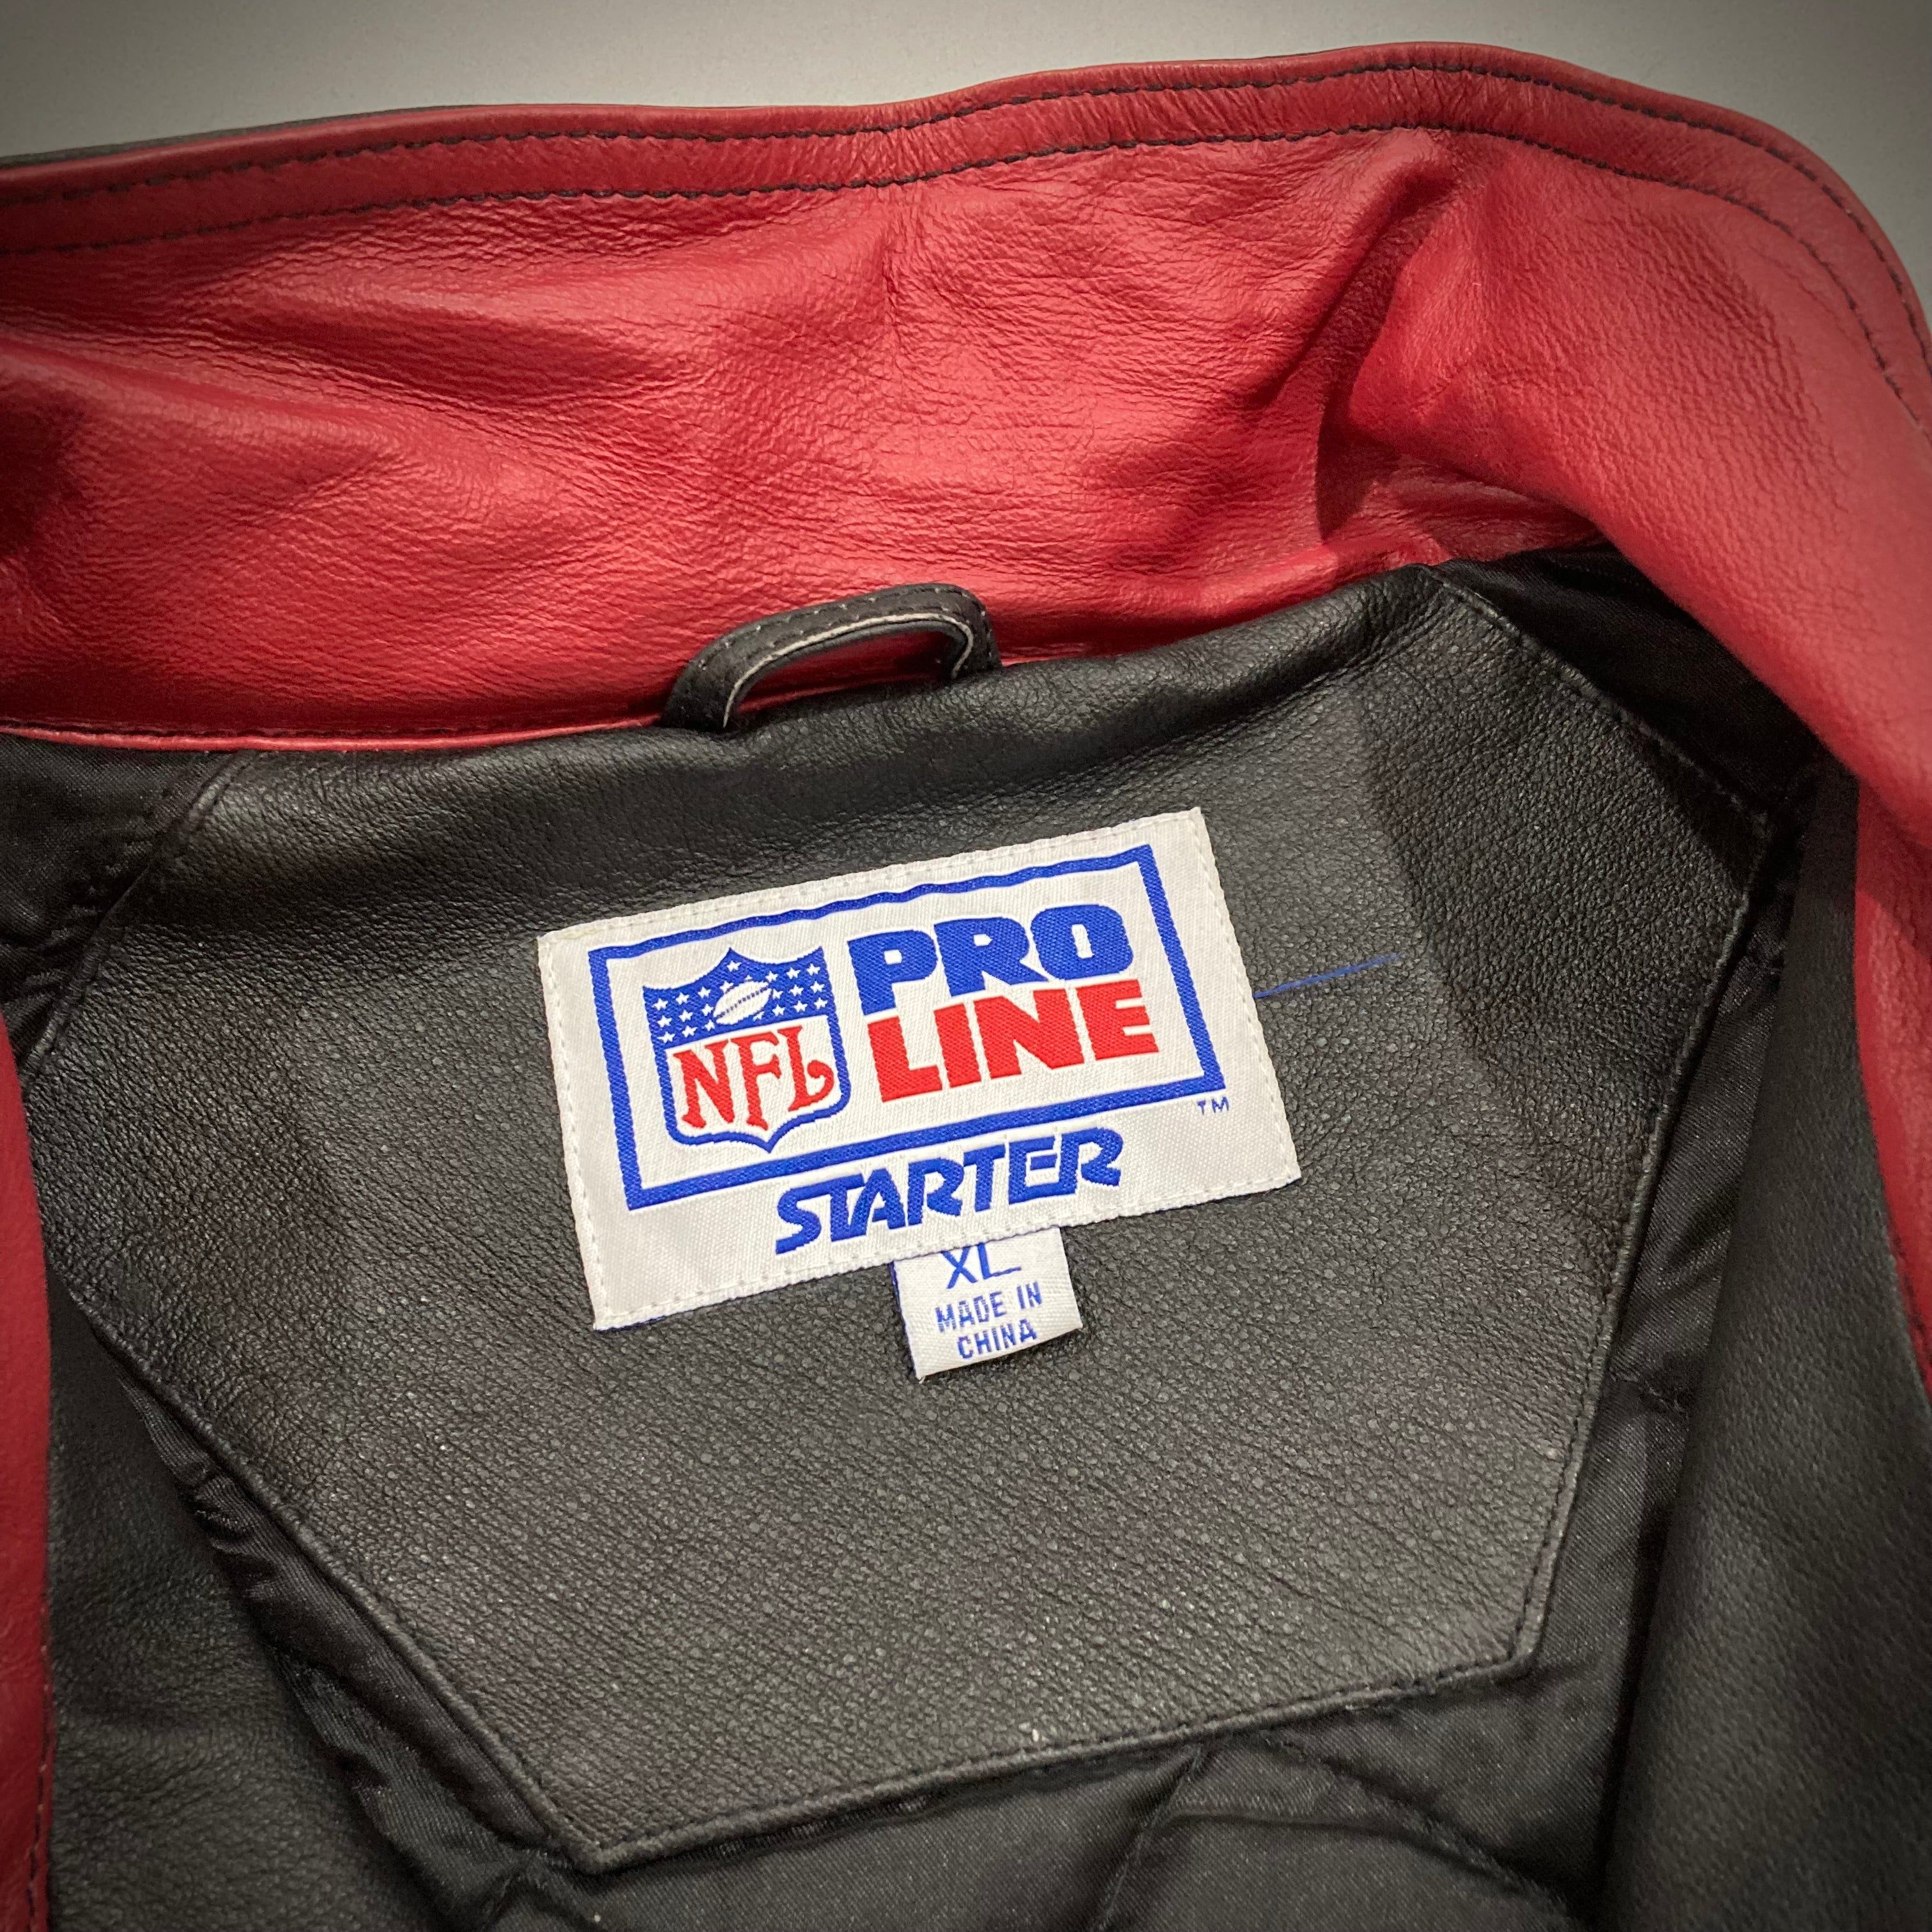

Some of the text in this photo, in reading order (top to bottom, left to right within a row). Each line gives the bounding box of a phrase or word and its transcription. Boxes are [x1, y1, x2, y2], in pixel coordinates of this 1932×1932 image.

[847, 904, 1134, 1015] PRO
[673, 1025, 834, 1131] NFL
[868, 979, 1159, 1103] LINE
[1197, 1096, 1229, 1115] TM
[774, 1127, 1123, 1255] STARTER
[940, 1242, 1022, 1289] XL
[935, 1282, 1043, 1332] MADE IN
[957, 1319, 1037, 1359] CHINA
